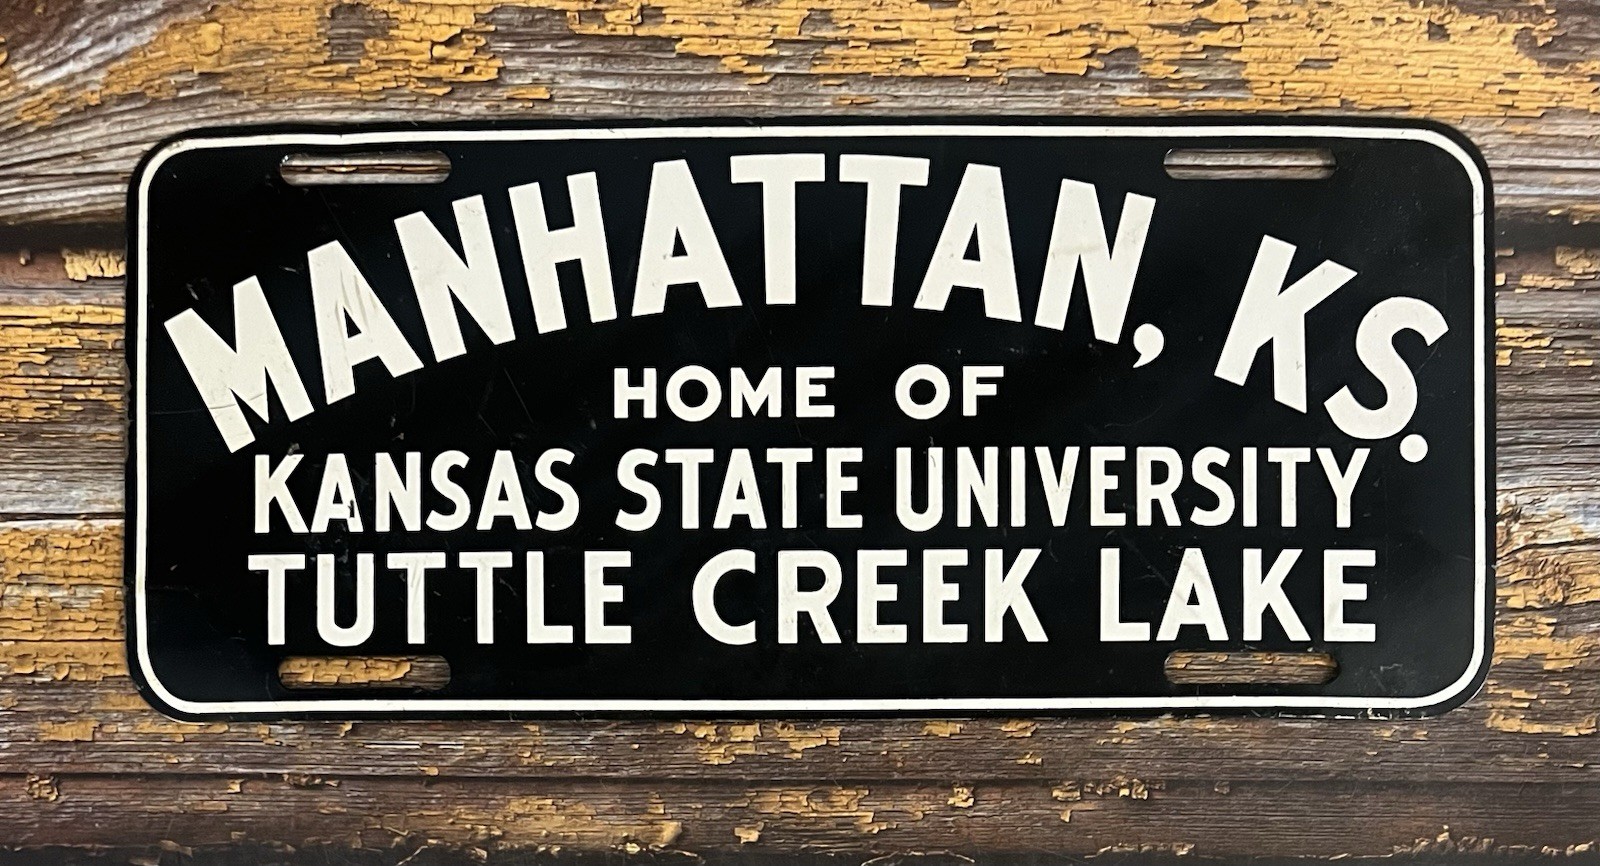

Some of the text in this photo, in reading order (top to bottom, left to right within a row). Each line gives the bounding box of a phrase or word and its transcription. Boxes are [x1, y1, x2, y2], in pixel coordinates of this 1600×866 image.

[163, 153, 1449, 463] MANHATTAN, KS.
[613, 363, 1005, 421] HOME OF
[254, 445, 1371, 534] KANSAS STATE UNIVERSITY
[248, 548, 1377, 646] TUTTLE CREEK LAKE
